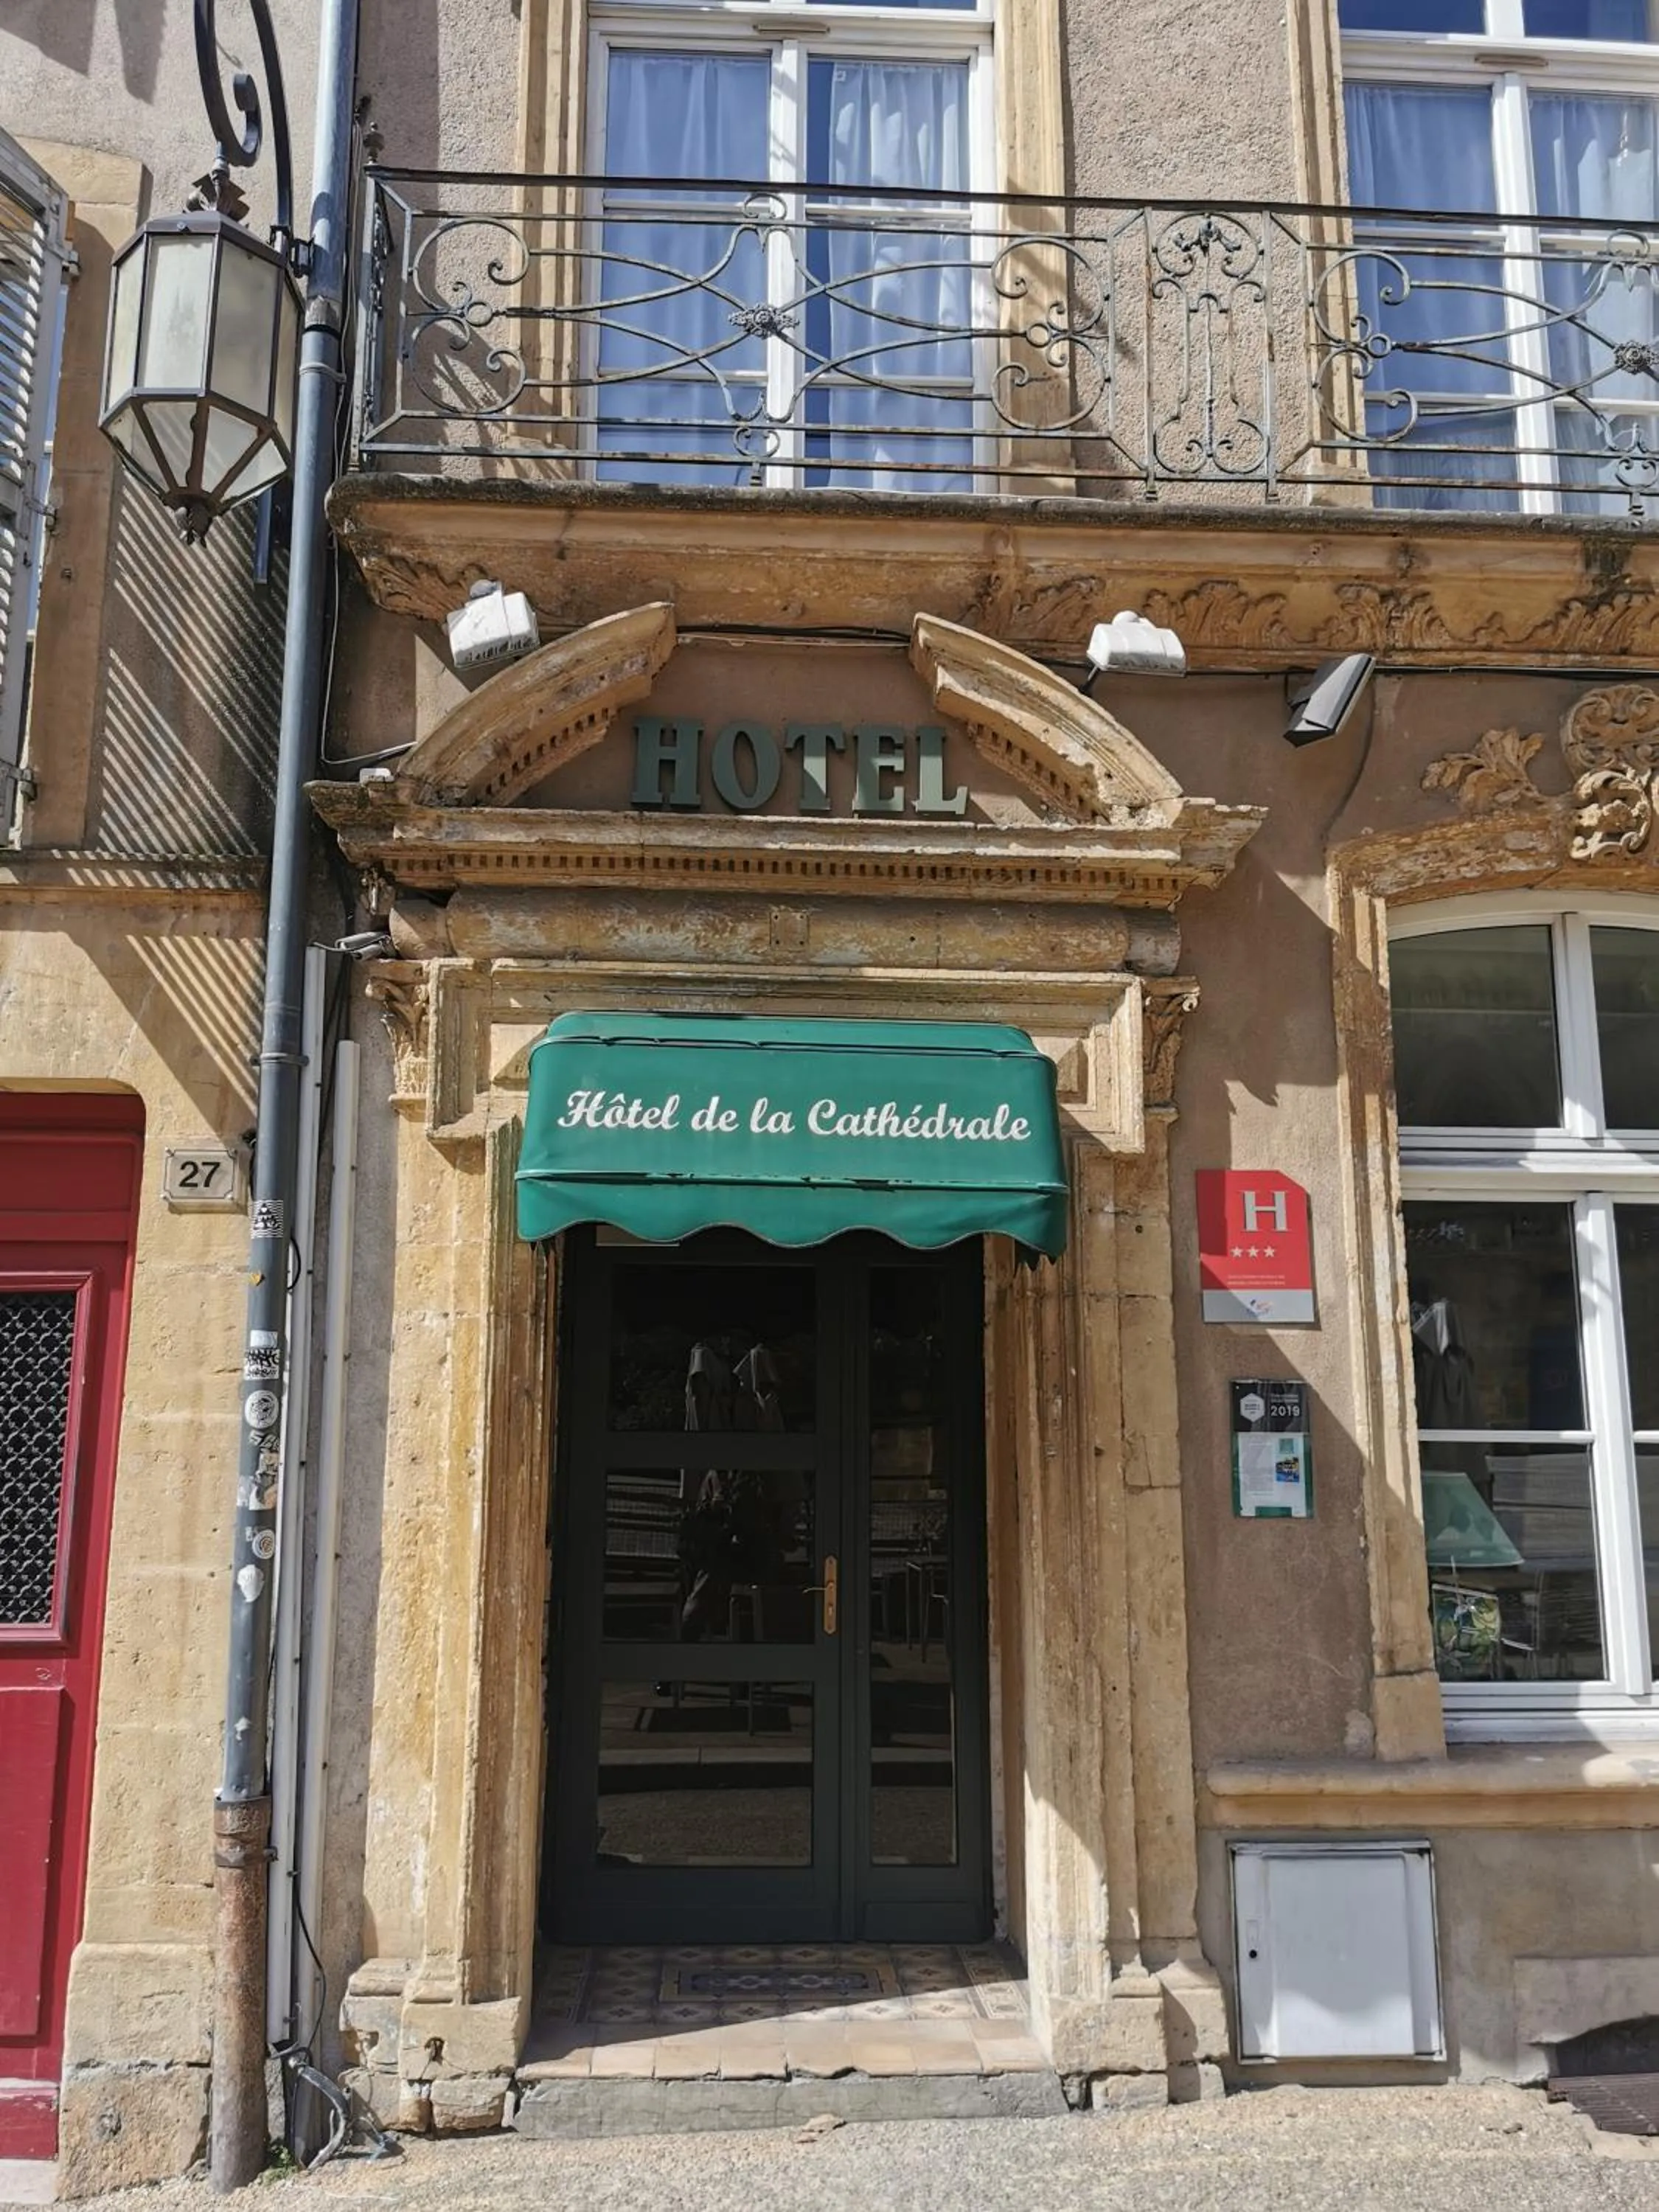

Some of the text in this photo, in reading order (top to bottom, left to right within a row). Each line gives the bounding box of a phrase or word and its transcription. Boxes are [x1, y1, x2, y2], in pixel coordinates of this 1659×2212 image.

[632, 717, 967, 815] HOTEL
[557, 1090, 1032, 1141] Hôtel de la Cathédrale
[178, 1161, 221, 1188] 27
[1242, 1190, 1289, 1232] H
[1270, 1405, 1300, 1416] 2019
